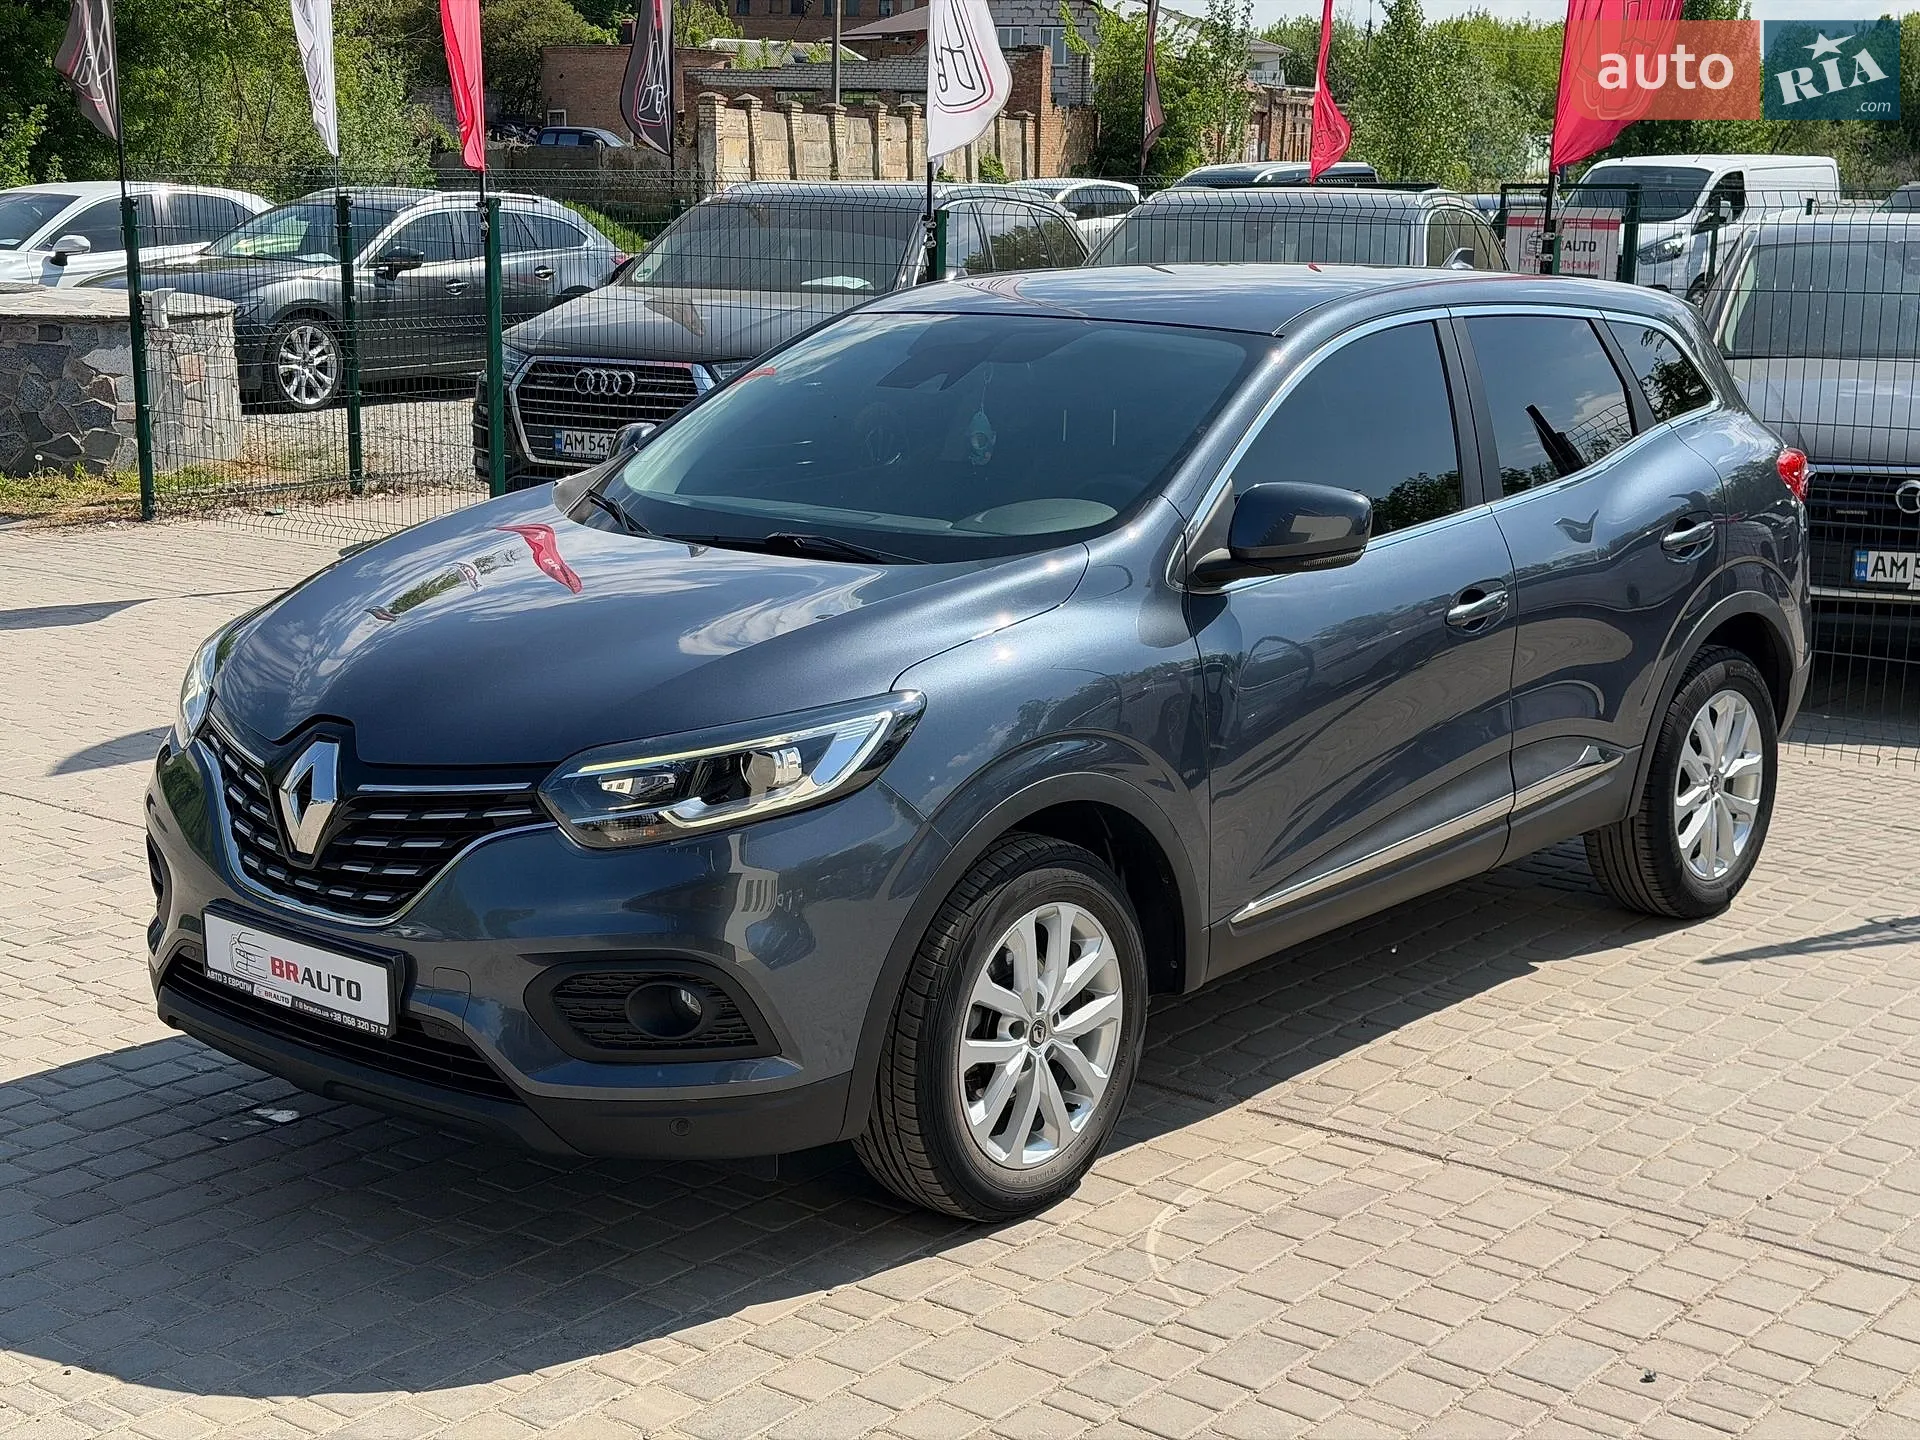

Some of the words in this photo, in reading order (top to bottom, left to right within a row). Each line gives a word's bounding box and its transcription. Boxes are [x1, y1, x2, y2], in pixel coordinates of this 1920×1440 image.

[563, 433, 585, 451] AM
[1870, 556, 1908, 579] AM
[270, 956, 362, 1002] BRAUTO
[264, 990, 290, 1005] BRAUTO
[356, 1019, 369, 1031] 320
[370, 1024, 379, 1034] 57
[379, 1026, 388, 1036] 57
